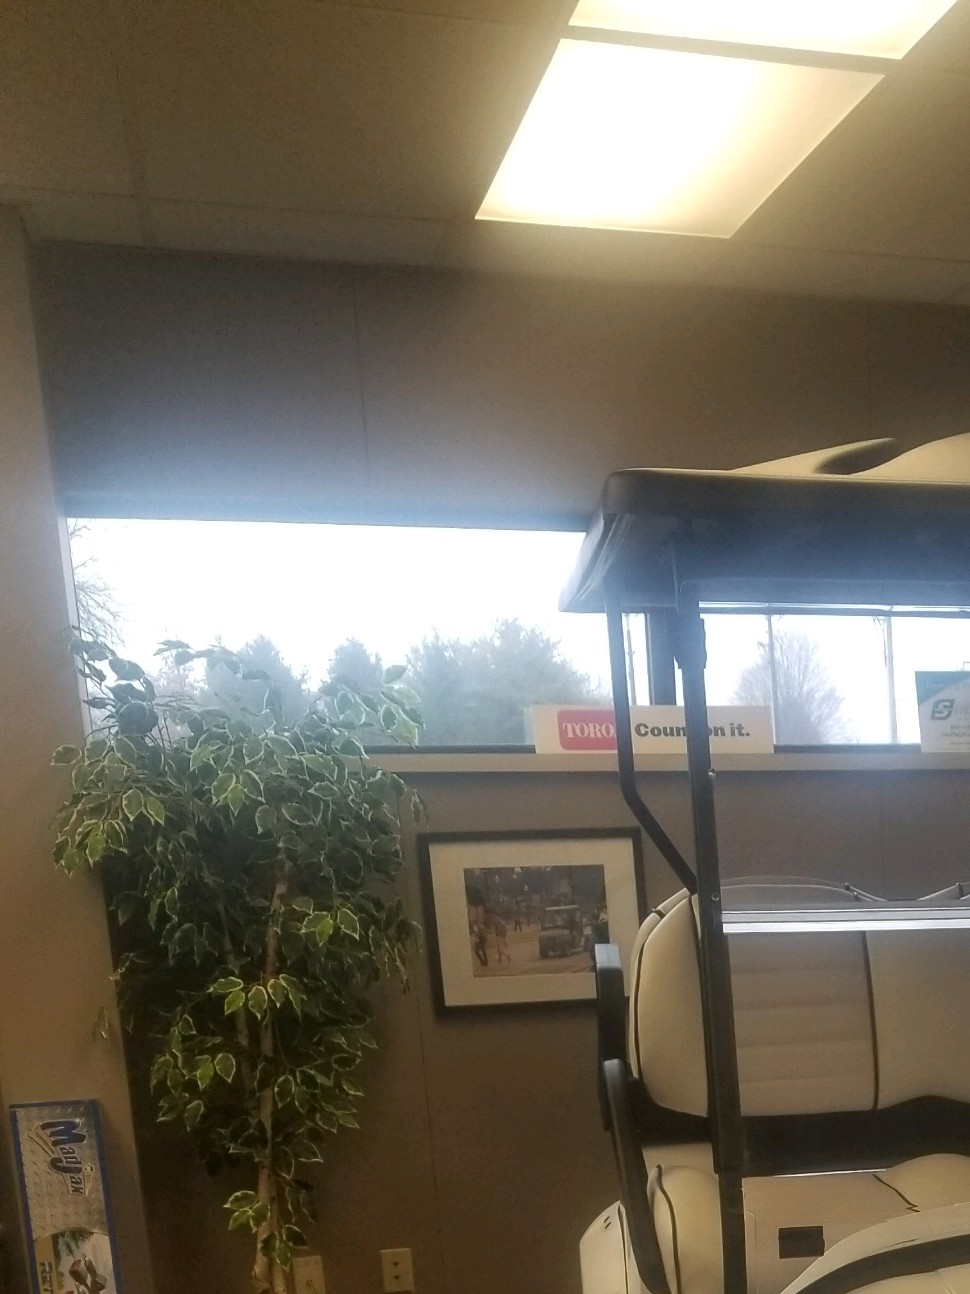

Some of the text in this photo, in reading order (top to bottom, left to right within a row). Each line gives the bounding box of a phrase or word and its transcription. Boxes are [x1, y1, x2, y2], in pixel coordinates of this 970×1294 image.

[562, 722, 615, 738] TORO
[634, 722, 688, 737] Coun
[729, 722, 750, 737] it.
